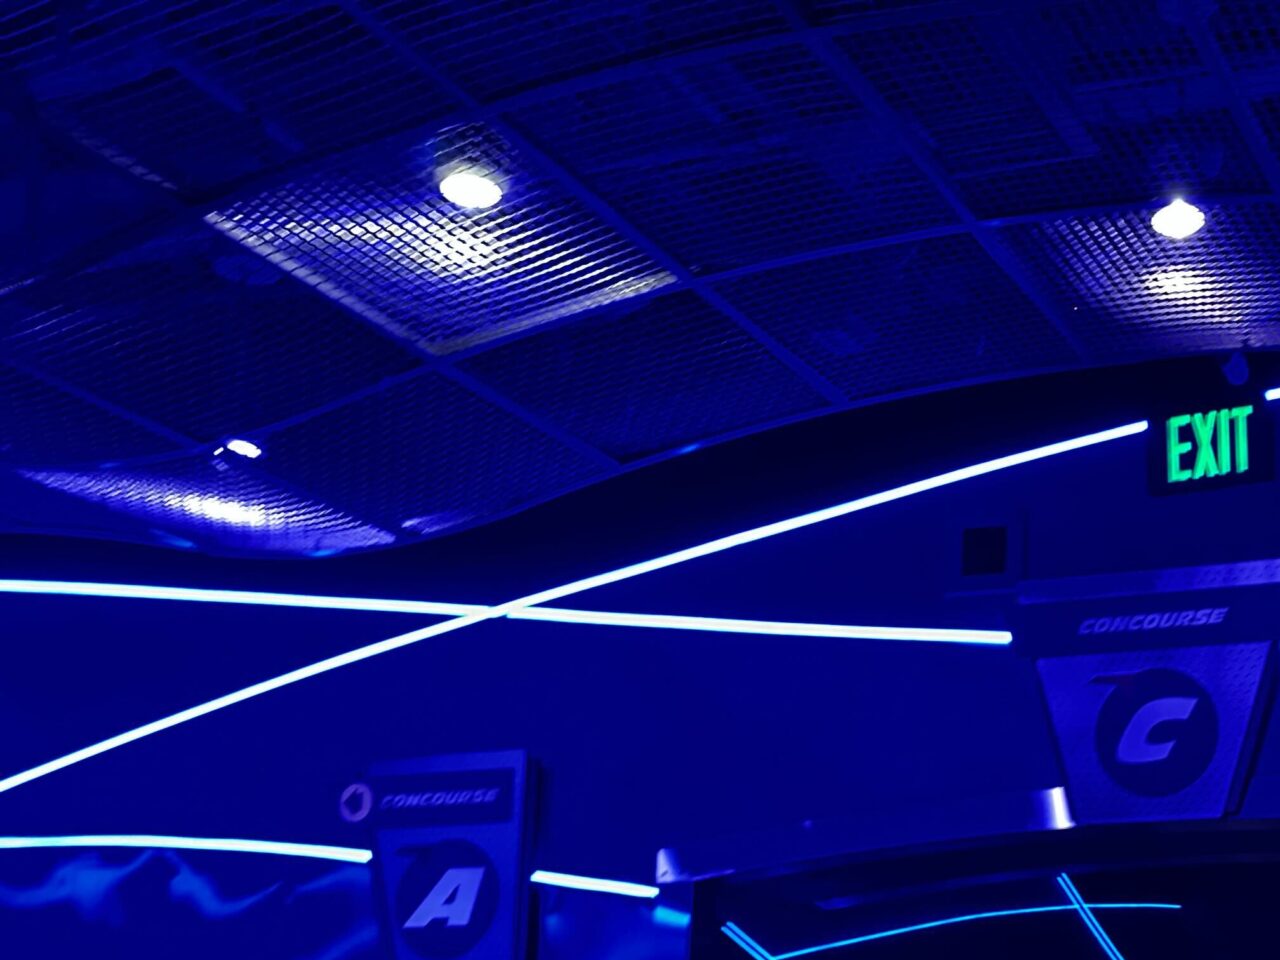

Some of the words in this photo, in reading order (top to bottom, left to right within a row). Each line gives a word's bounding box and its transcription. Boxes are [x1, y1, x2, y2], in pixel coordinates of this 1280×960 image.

[1166, 405, 1253, 483] EXIT
[1077, 606, 1229, 635] CONCOURSE
[1116, 697, 1199, 763] C
[380, 788, 500, 809] CONCOURSE
[402, 867, 485, 929] A
